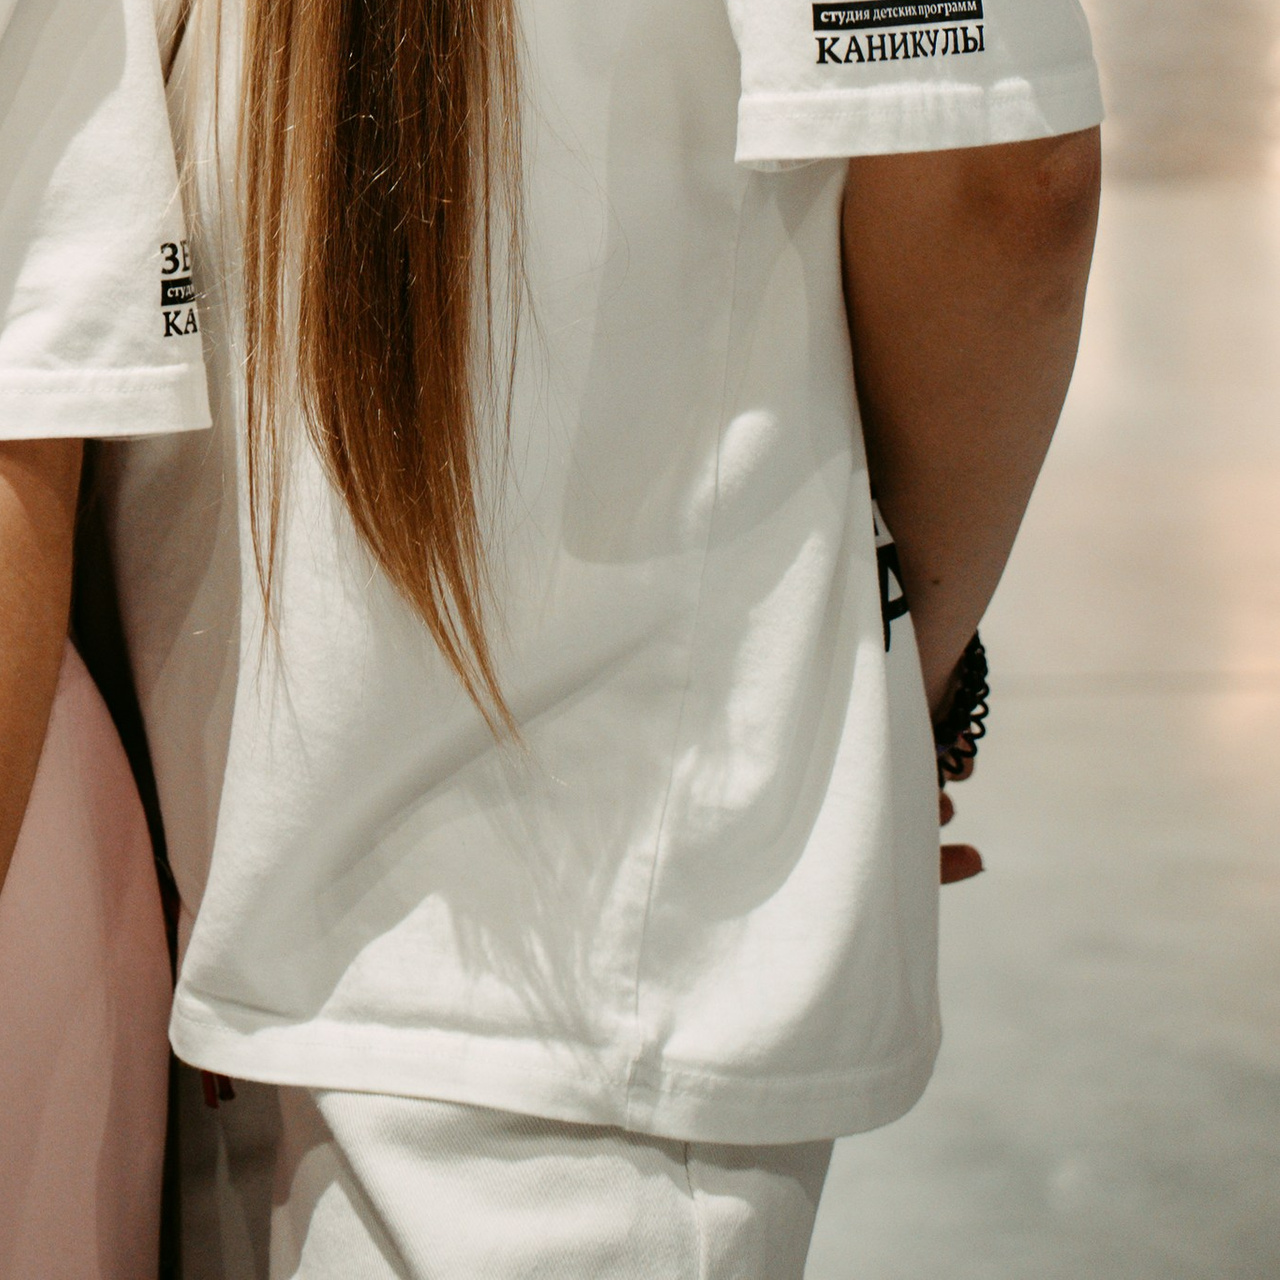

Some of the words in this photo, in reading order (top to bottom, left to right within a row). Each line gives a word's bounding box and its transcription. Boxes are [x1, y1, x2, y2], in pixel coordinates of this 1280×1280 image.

[820, 10, 870, 25] студия
[872, 5, 918, 20] детских
[919, 0, 977, 18] программ
[815, 25, 985, 64] КАНИКУЛЫ
